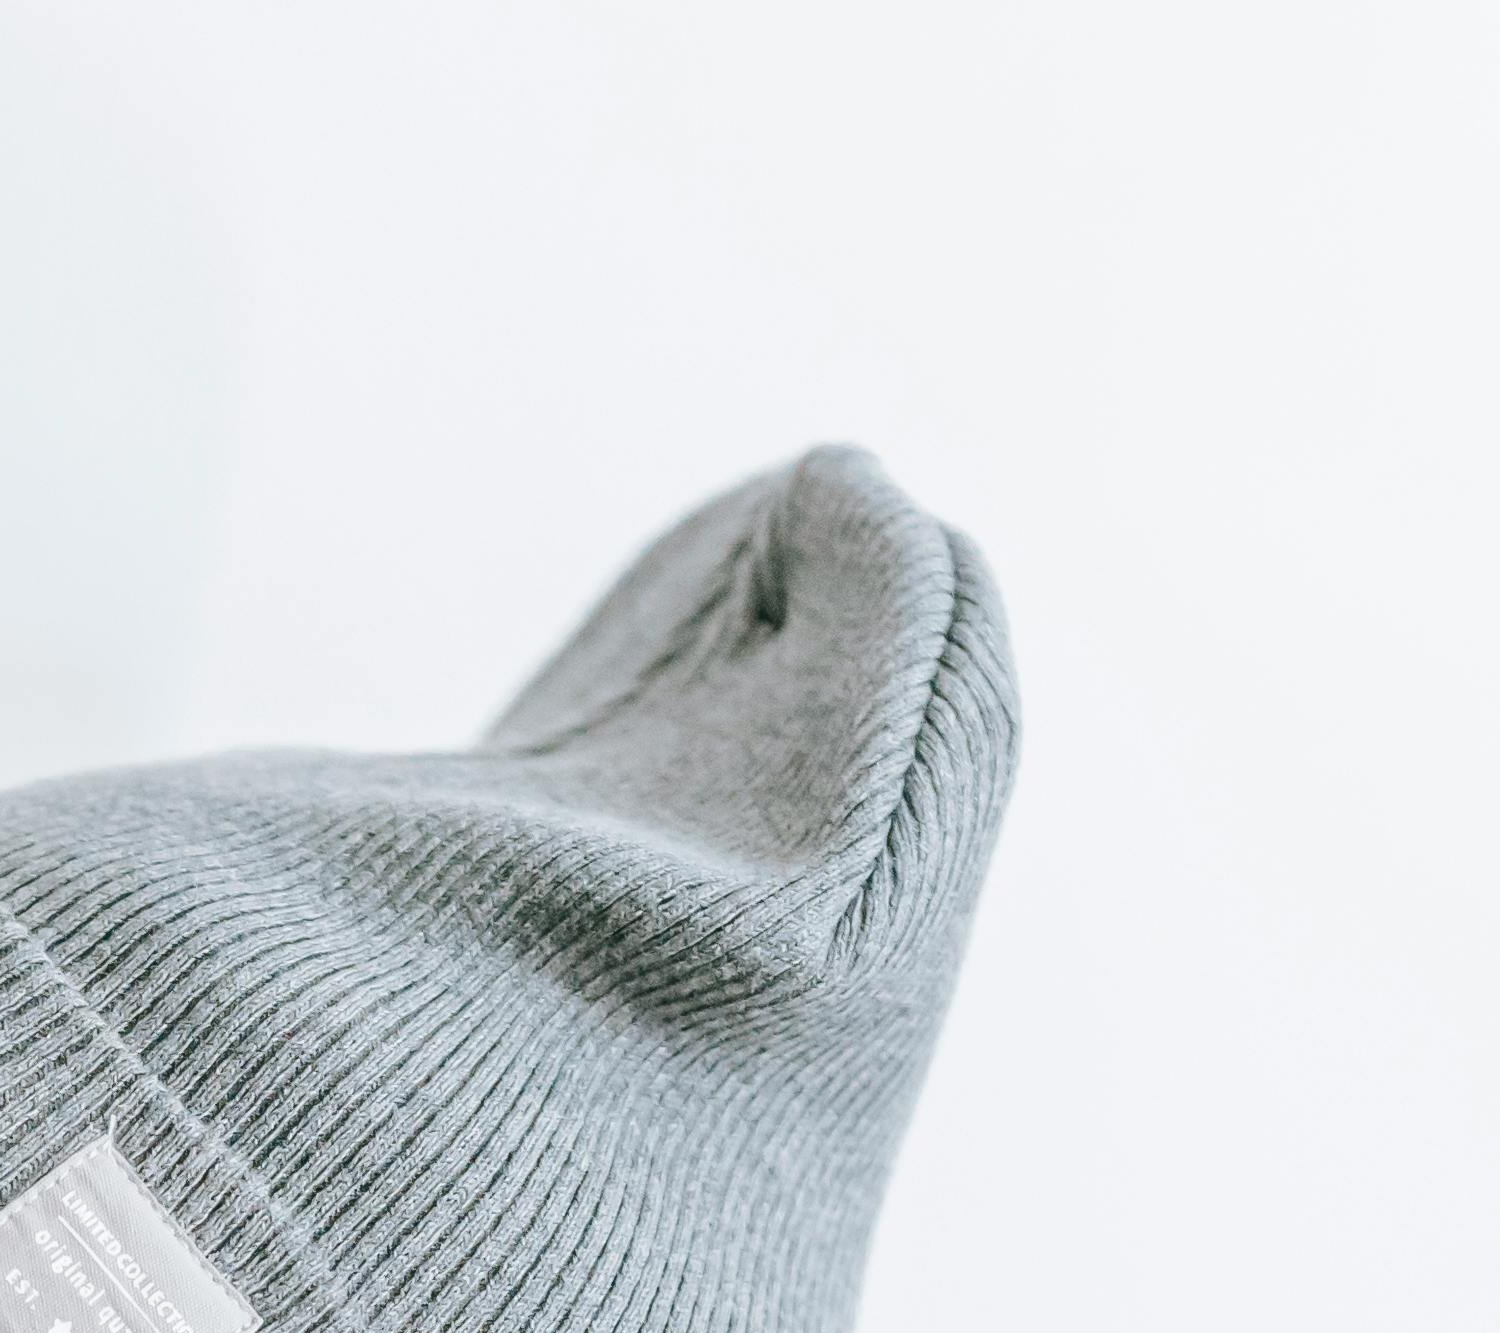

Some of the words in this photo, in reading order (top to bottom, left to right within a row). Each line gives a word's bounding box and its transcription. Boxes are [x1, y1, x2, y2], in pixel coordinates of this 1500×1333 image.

[62, 1190, 121, 1256] LIMITED
[5, 1268, 40, 1310] EST.
[35, 1230, 105, 1306] original
